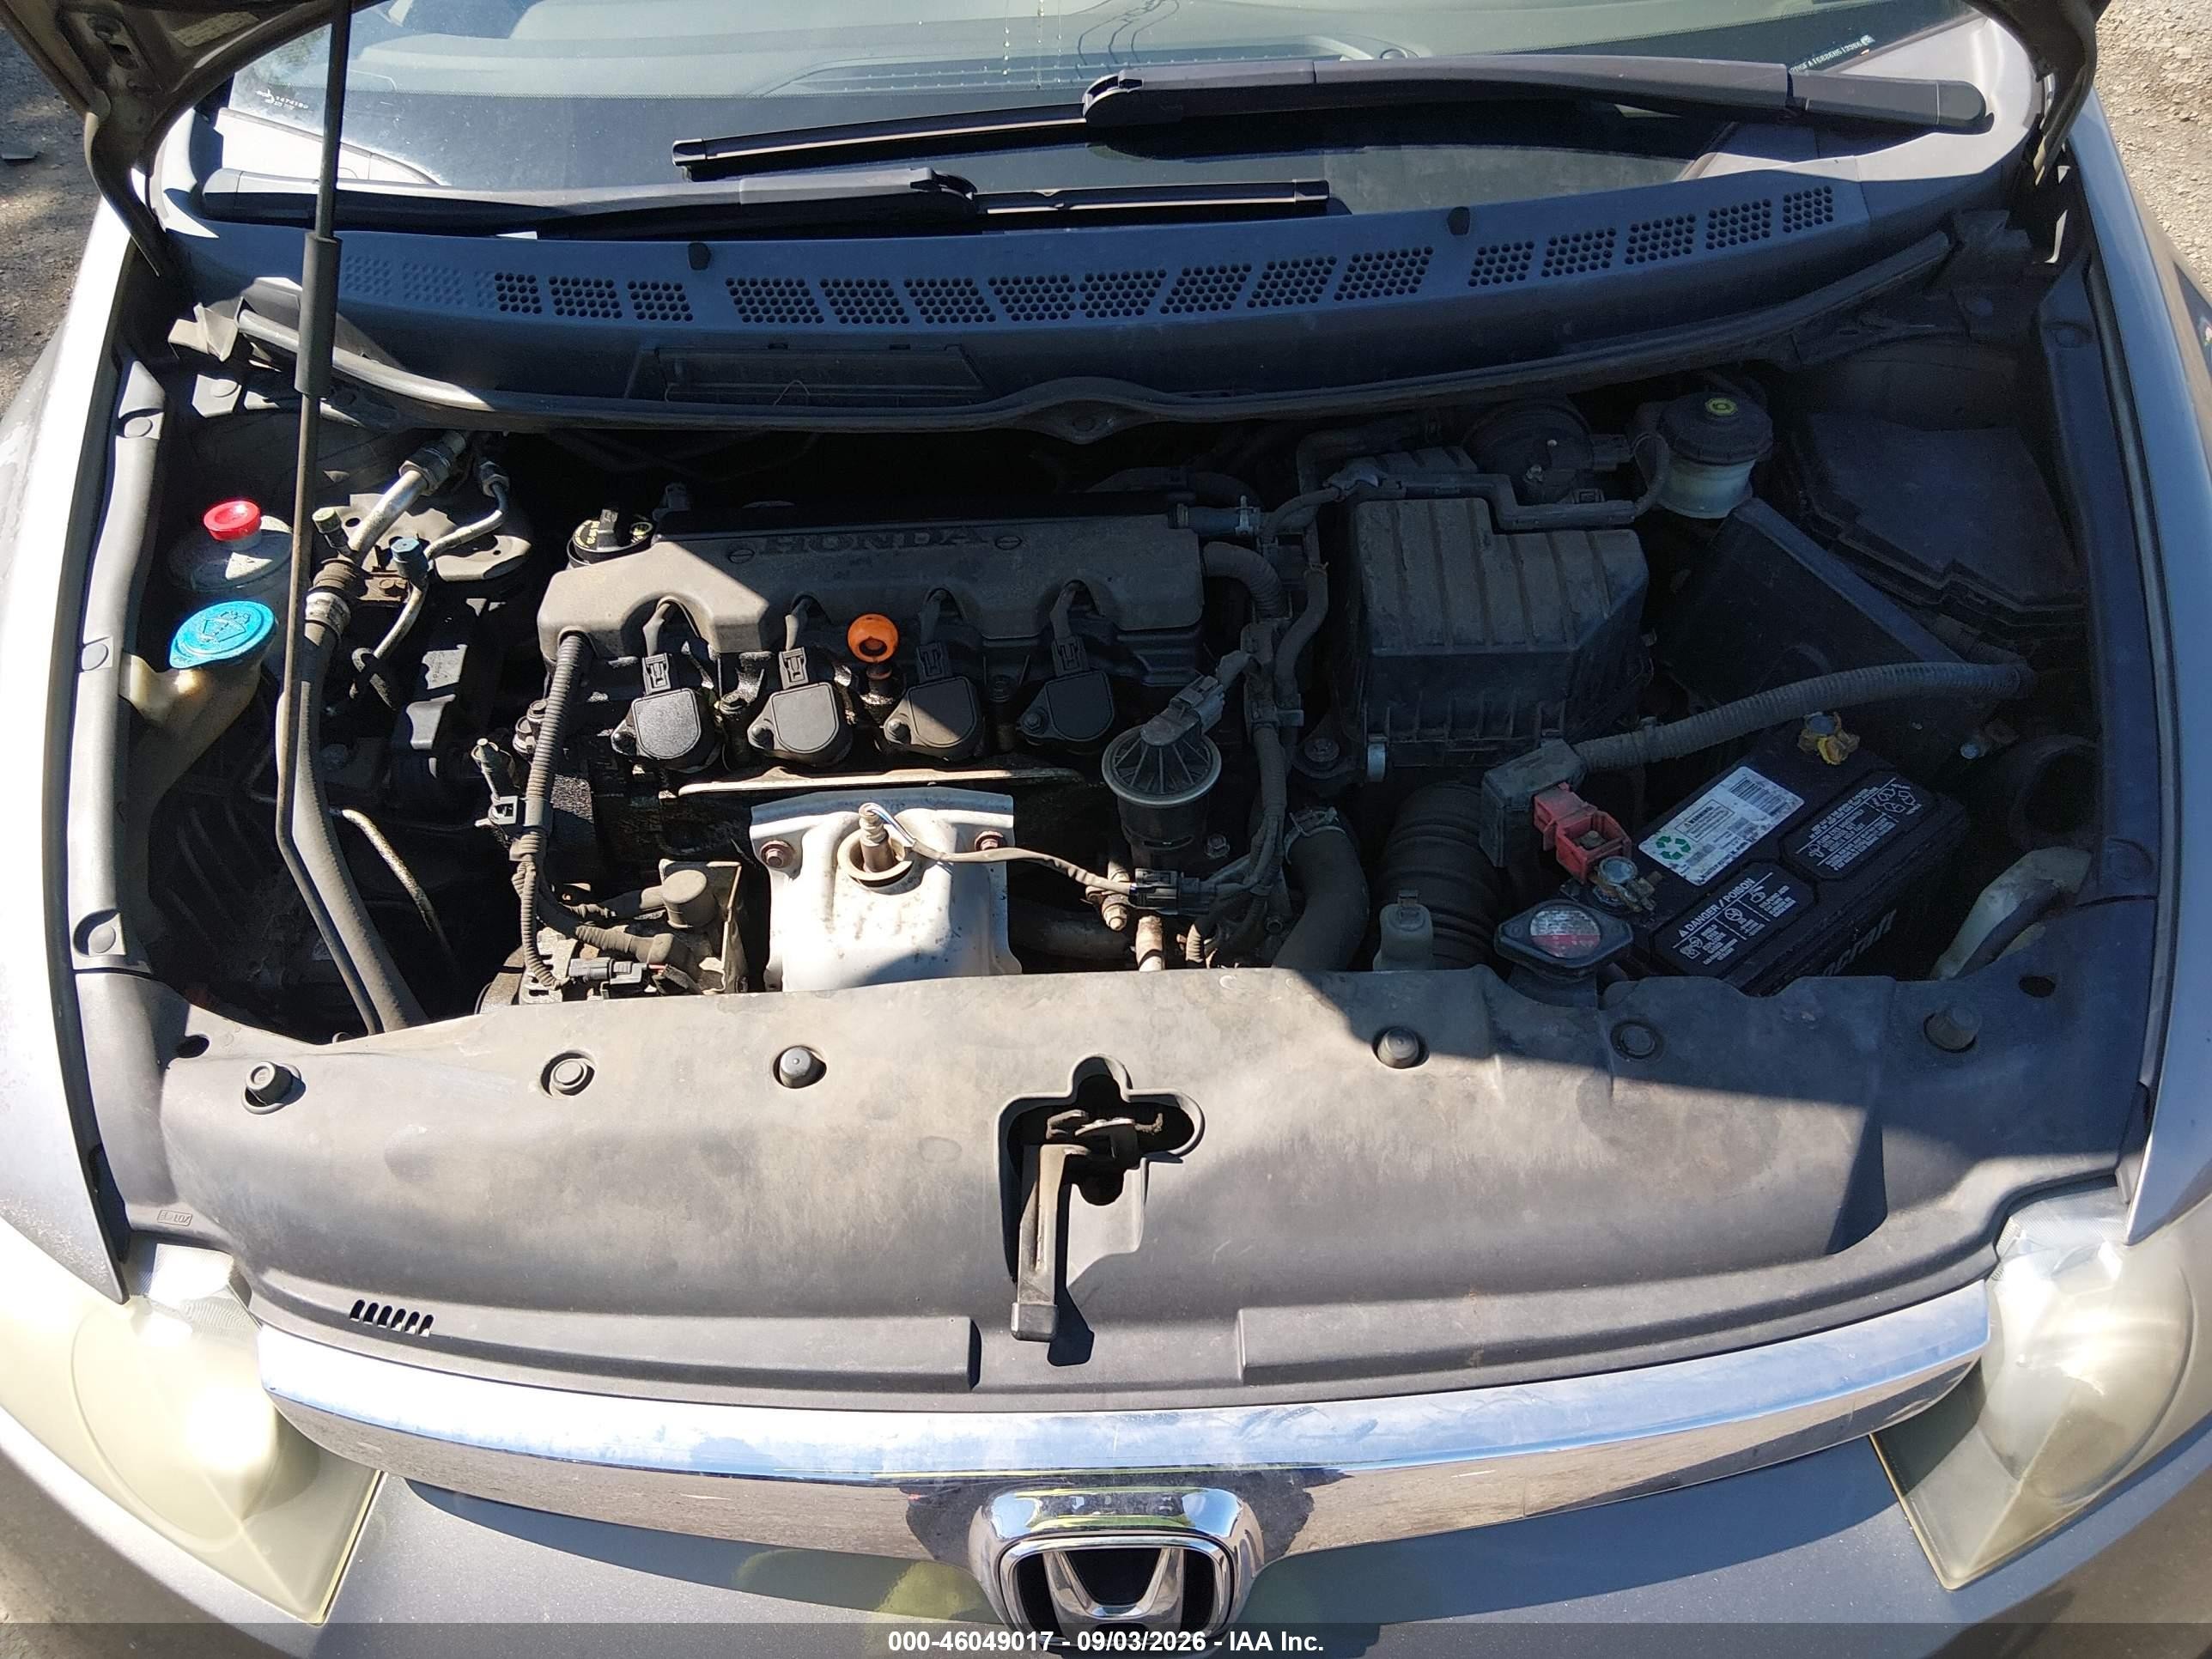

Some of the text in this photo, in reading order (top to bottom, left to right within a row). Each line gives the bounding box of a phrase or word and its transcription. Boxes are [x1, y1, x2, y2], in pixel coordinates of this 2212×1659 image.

[760, 526, 988, 556] HONDA
[1682, 902, 1722, 932] DANGER
[1721, 877, 1756, 902] POISON
